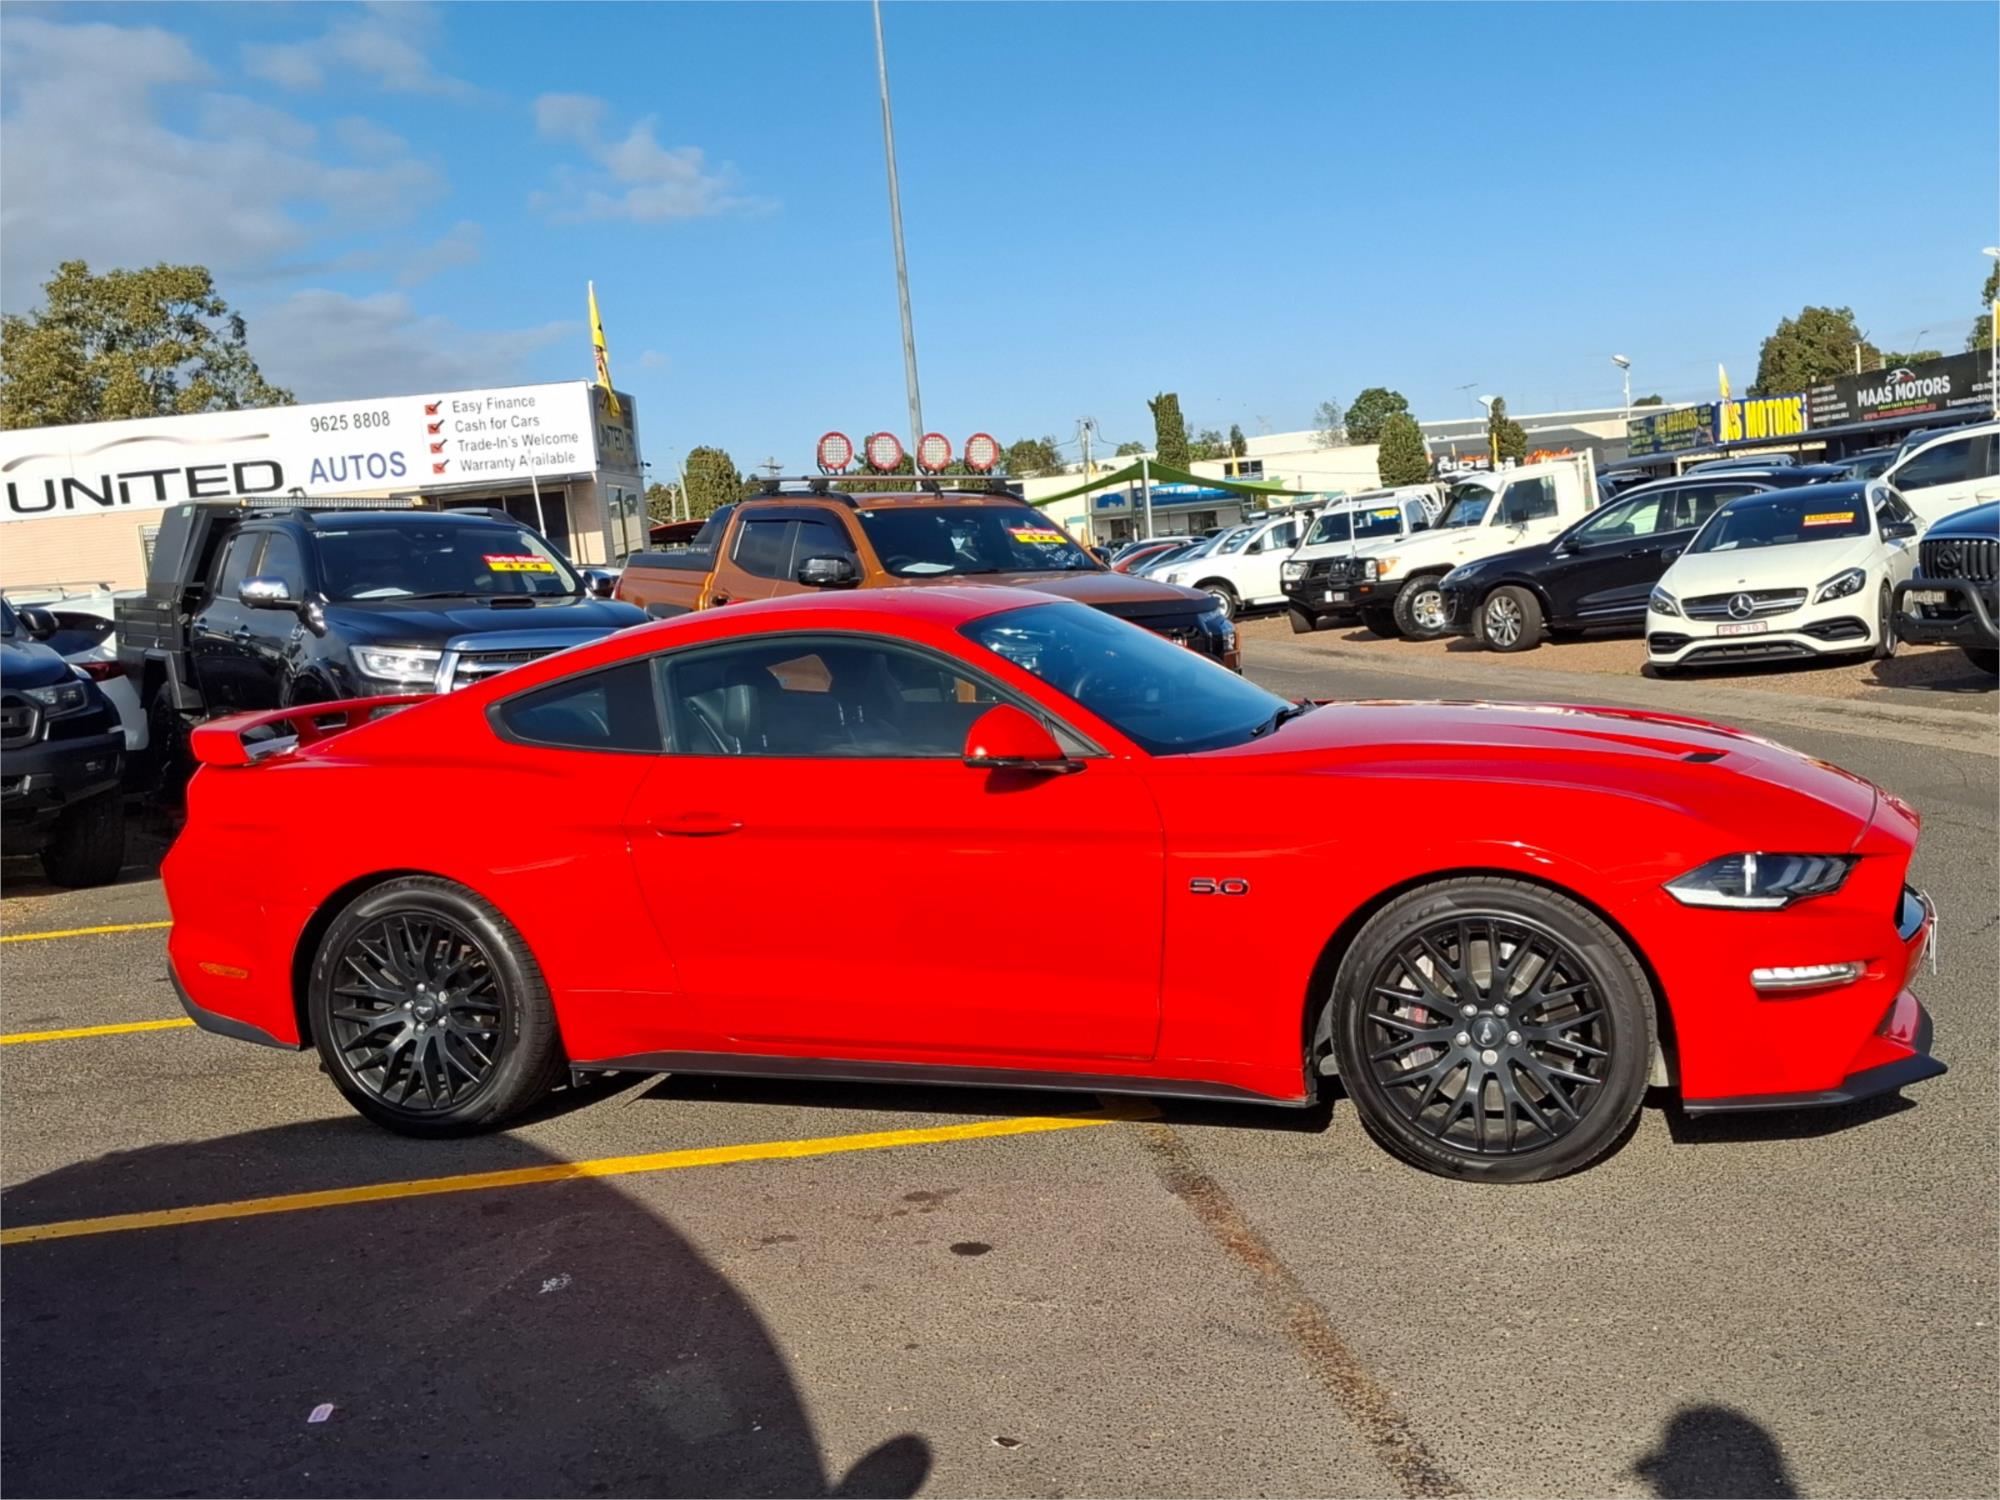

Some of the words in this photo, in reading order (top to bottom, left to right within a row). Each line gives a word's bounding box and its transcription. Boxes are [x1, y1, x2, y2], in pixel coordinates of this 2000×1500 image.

[1857, 384, 1893, 408] MAAS
[1895, 375, 1951, 400] MOTORS
[452, 399, 482, 415] Easy
[486, 396, 536, 411] Finance
[310, 413, 349, 433] 9625
[353, 410, 391, 430] 8808
[455, 419, 487, 433] Cash
[490, 418, 509, 430] for
[511, 415, 540, 428] Cars
[1744, 396, 1802, 439] MOTORS
[457, 436, 519, 453] Trade-In's
[521, 431, 579, 447] Welcome
[310, 451, 407, 484] AUTOS
[460, 456, 516, 473] Warranty
[1189, 877, 1250, 896] 5.0
